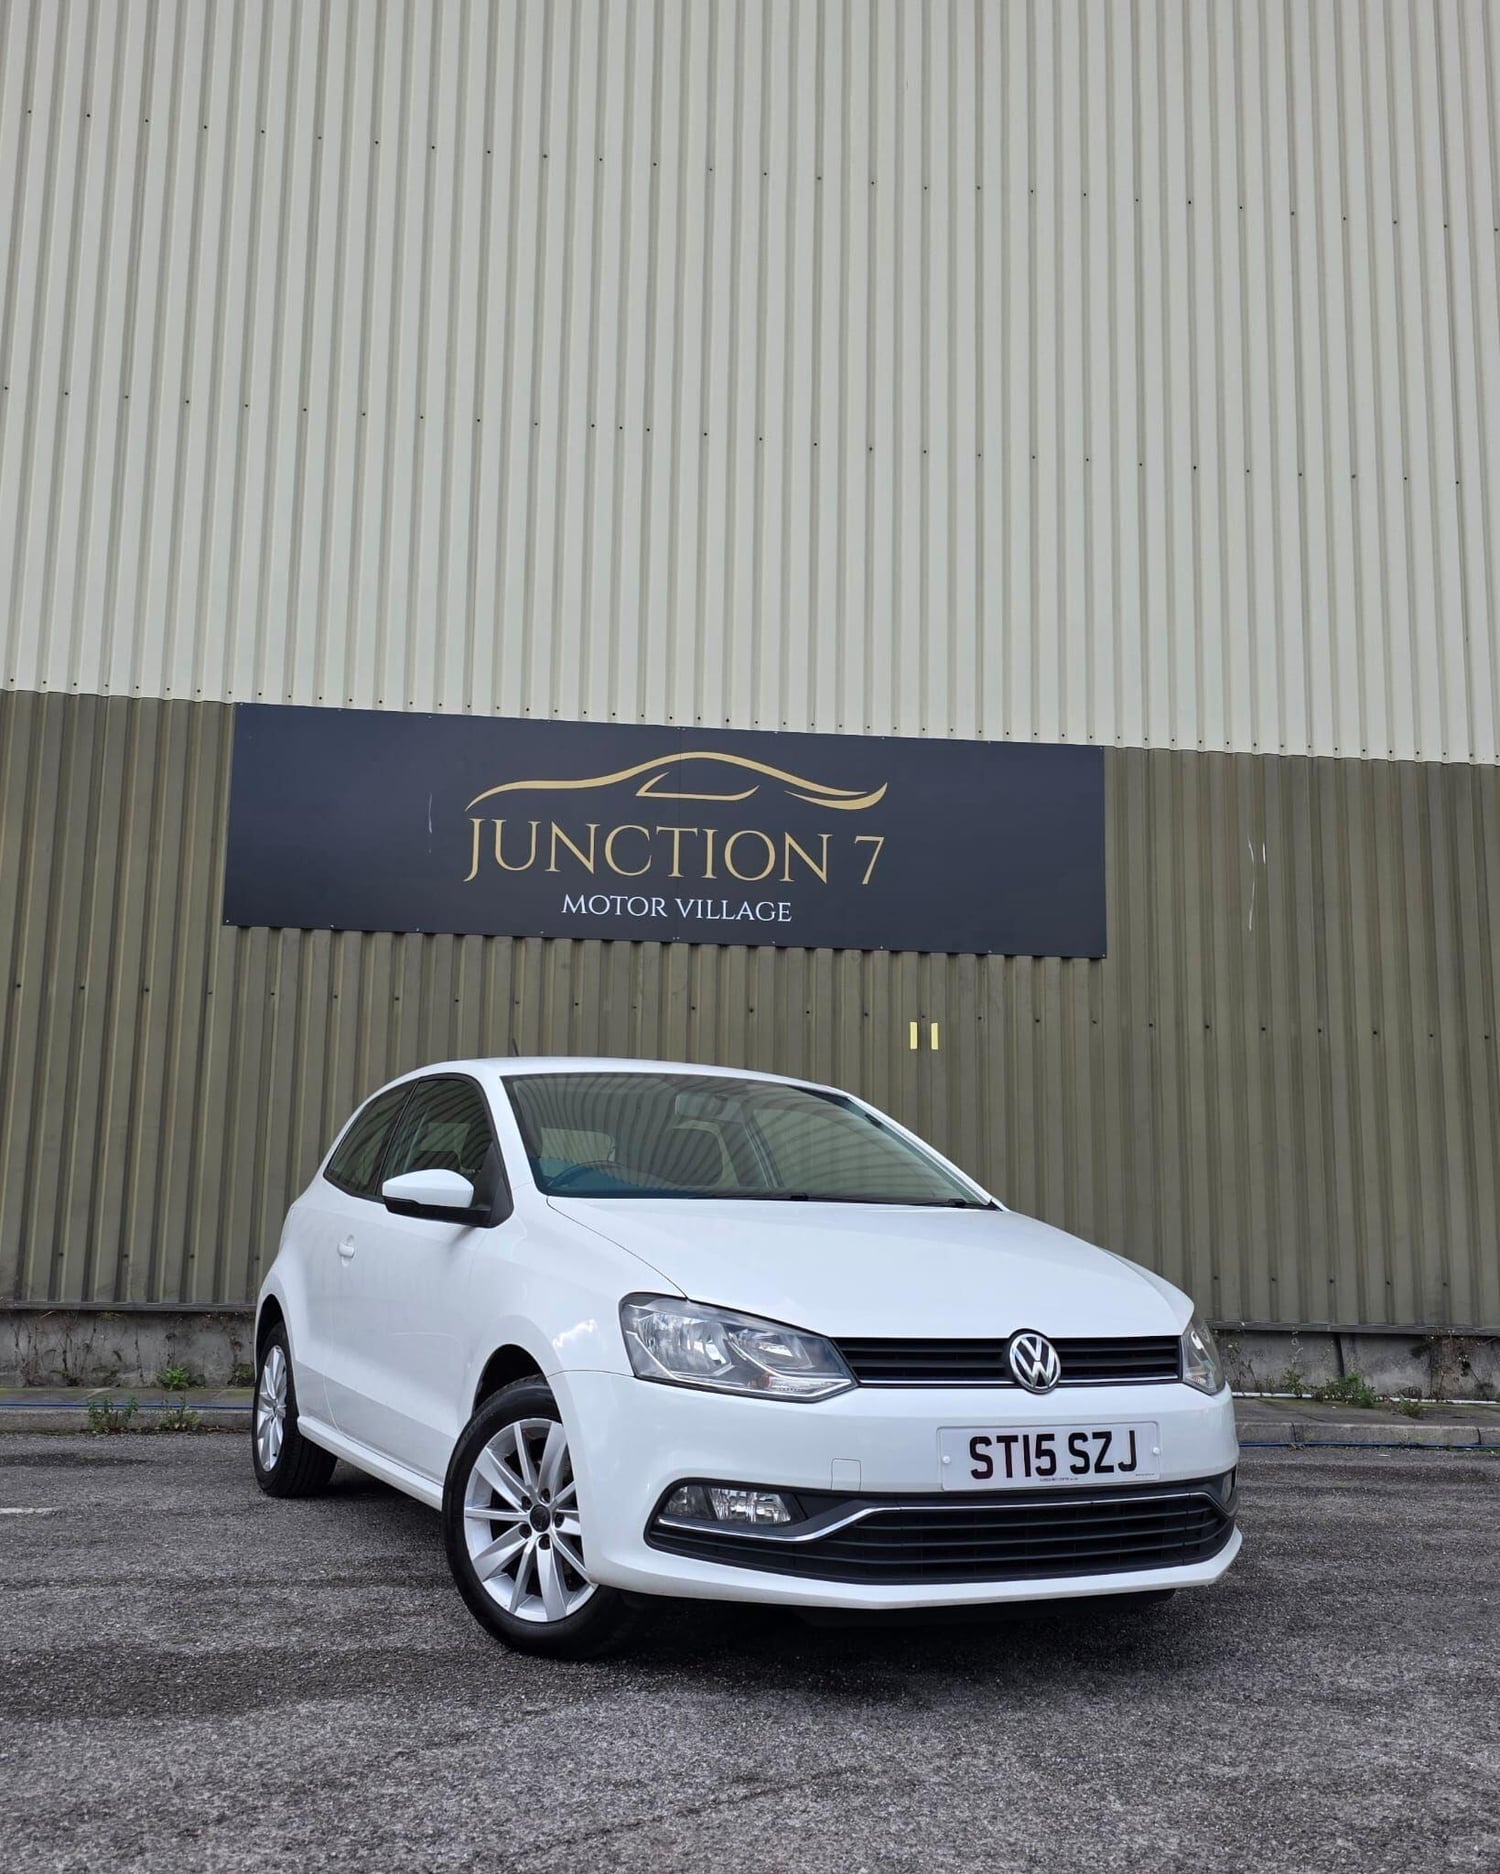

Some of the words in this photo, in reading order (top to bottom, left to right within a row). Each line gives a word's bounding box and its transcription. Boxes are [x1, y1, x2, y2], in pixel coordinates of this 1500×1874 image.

[463, 817, 833, 885] JUNCTION
[854, 835, 885, 885] 7
[561, 893, 668, 917] MOTOR
[675, 898, 792, 922] VILLAGE
[1009, 1334, 1061, 1389] VW
[969, 1433, 1057, 1480] ST15
[1067, 1430, 1138, 1475] SZJ
